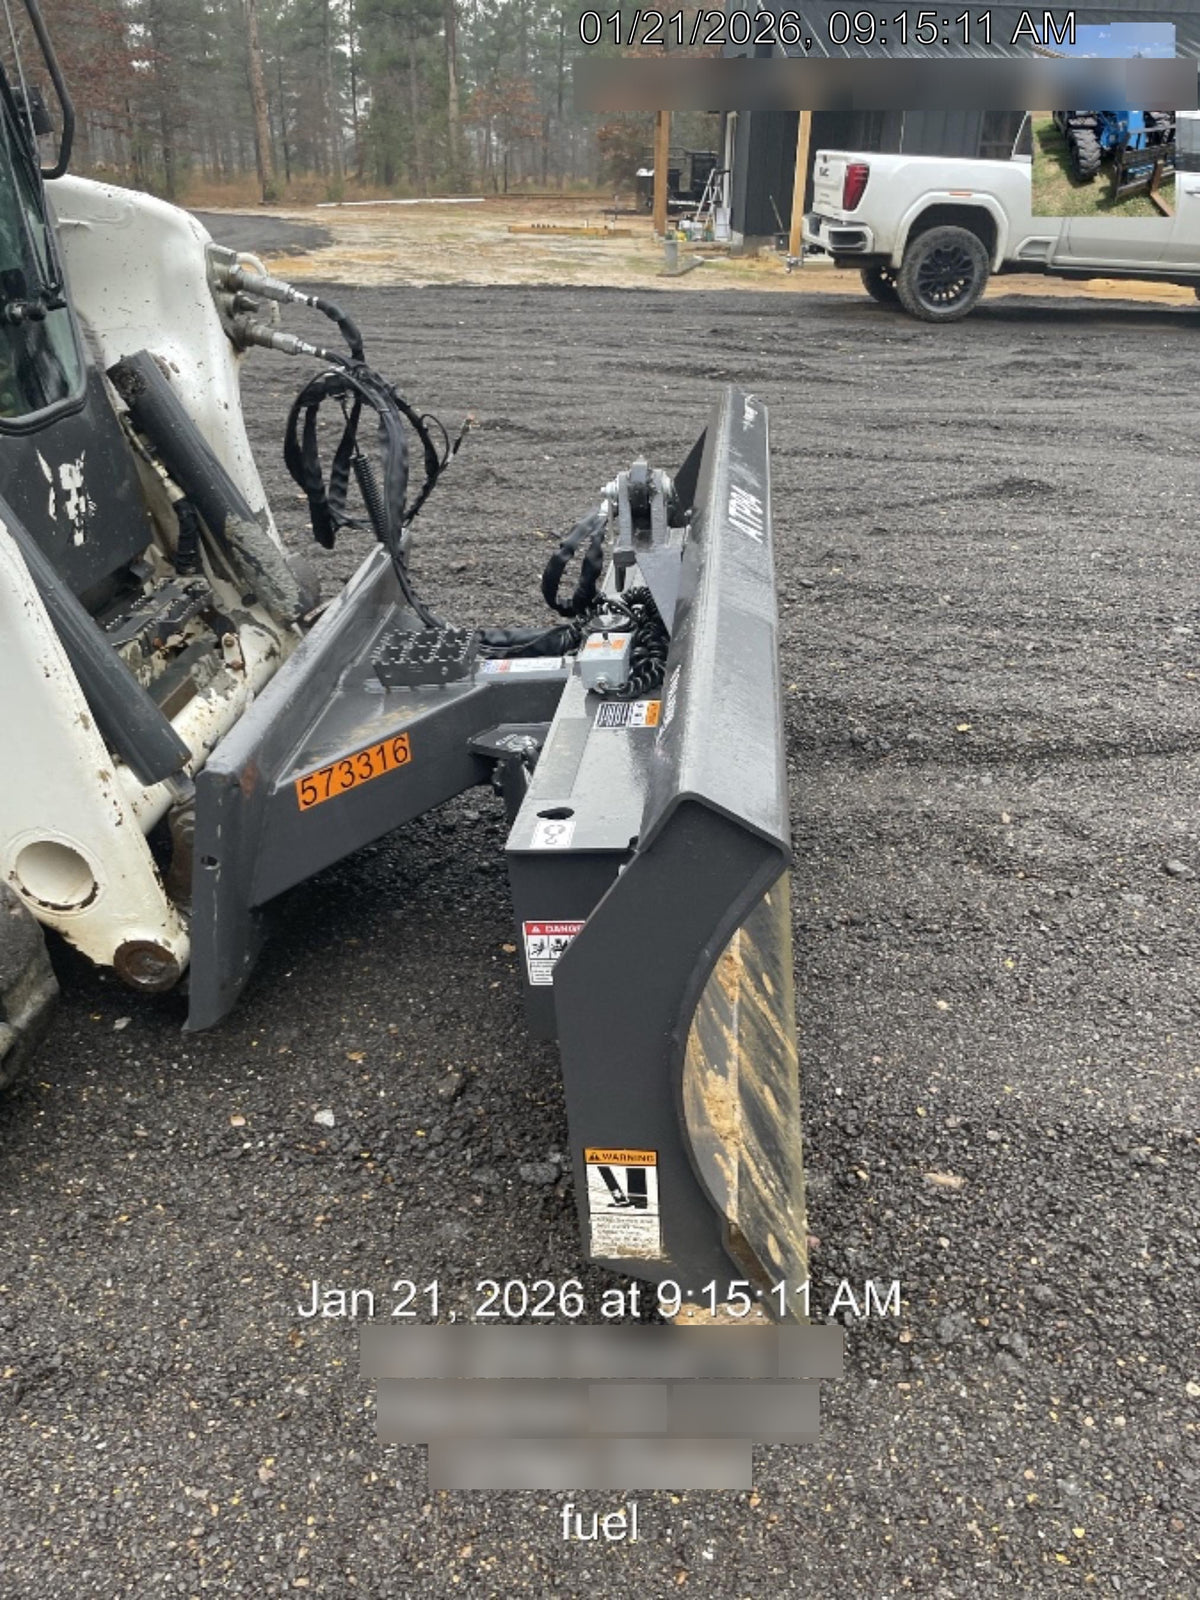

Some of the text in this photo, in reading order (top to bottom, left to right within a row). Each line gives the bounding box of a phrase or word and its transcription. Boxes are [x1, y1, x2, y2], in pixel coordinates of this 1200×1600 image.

[299, 736, 409, 807] 573316
[545, 924, 583, 934] DANGE
[602, 1152, 655, 1162] WARNING
